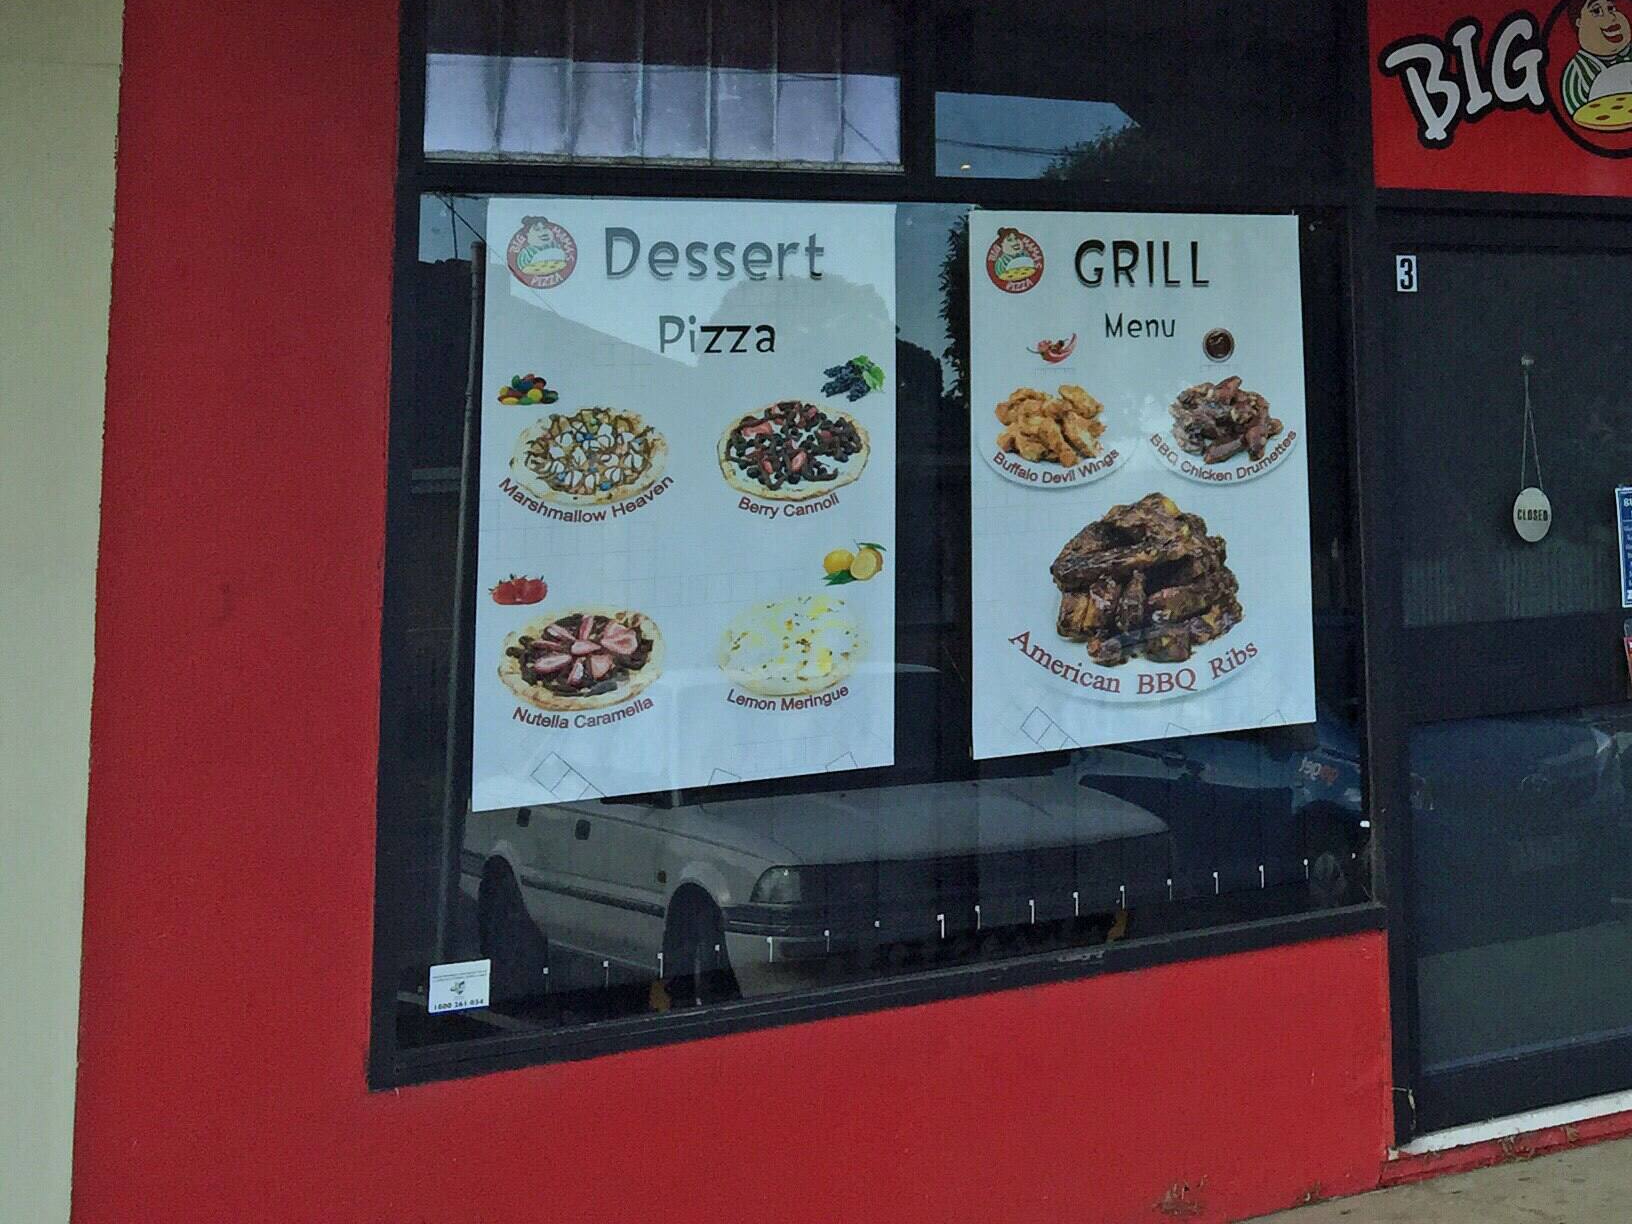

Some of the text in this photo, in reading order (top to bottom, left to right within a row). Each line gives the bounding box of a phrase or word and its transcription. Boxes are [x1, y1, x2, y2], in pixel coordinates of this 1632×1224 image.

[1379, 11, 1548, 148] BIG
[605, 227, 824, 280] Dessert
[1075, 239, 1210, 287] GRILL
[1399, 259, 1415, 290] 3
[659, 315, 775, 353] Pizza
[1105, 312, 1176, 338] Menu
[993, 449, 1120, 484] Buffalo Devil Wings
[1150, 430, 1297, 481] BBQ Chicken Drumettes
[499, 474, 674, 523] Marshmallow Heaven
[738, 492, 840, 519] Berry Cannoli
[1517, 508, 1549, 522] CLOSED
[1008, 631, 1259, 695] American BBQ Ribs
[512, 696, 654, 729] Nutella Caramella
[726, 685, 850, 711] Lemon Meringue
